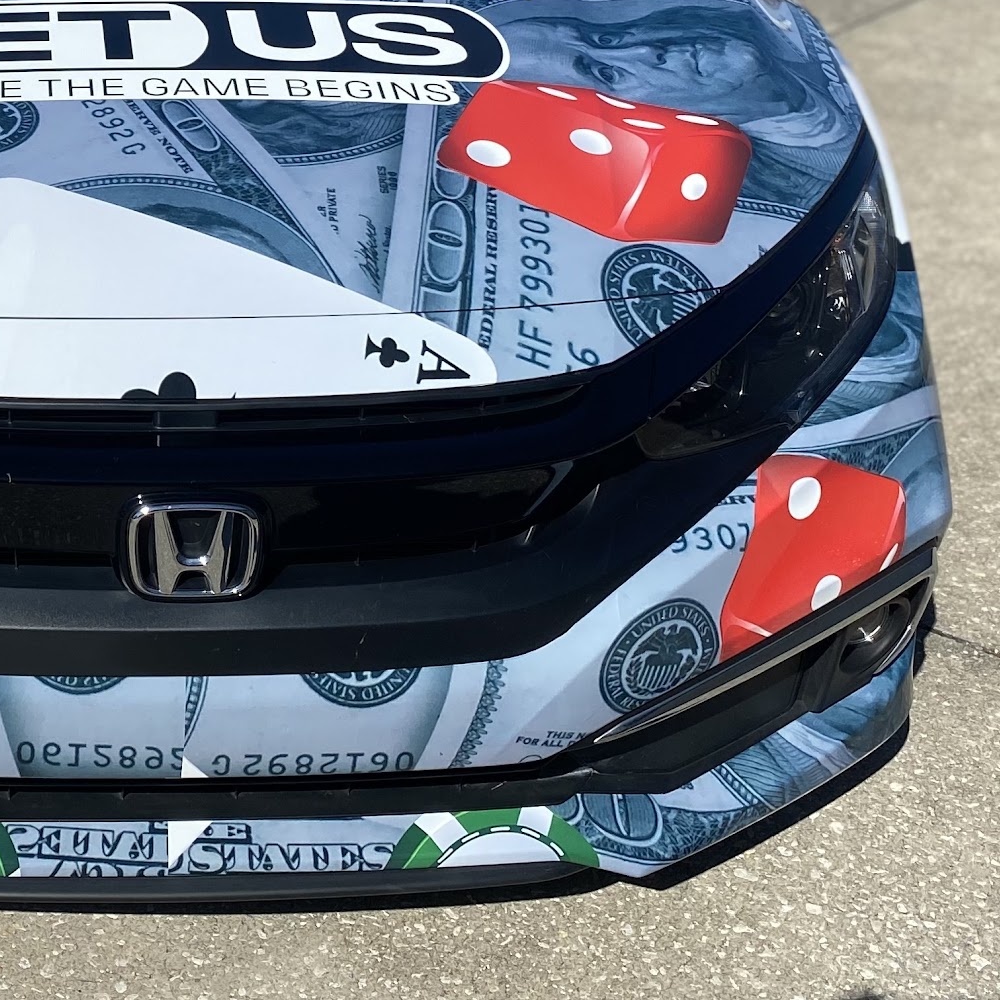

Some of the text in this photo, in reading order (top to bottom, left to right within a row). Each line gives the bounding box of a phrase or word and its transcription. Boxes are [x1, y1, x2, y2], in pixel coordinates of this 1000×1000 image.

[39, 78, 128, 99] THE
[142, 77, 269, 99] GAME
[285, 77, 452, 104] BEGINS
[158, 137, 194, 174] NOTE
[326, 187, 338, 222] PRIVATE
[478, 263, 498, 352] EDERAL
[416, 339, 471, 385] A
[631, 606, 711, 638] UNITED STATES
[607, 649, 628, 702] FEDERAL
[515, 736, 564, 748] FOR ALL
[546, 730, 574, 740] THIS
[188, 842, 395, 874] STATES
